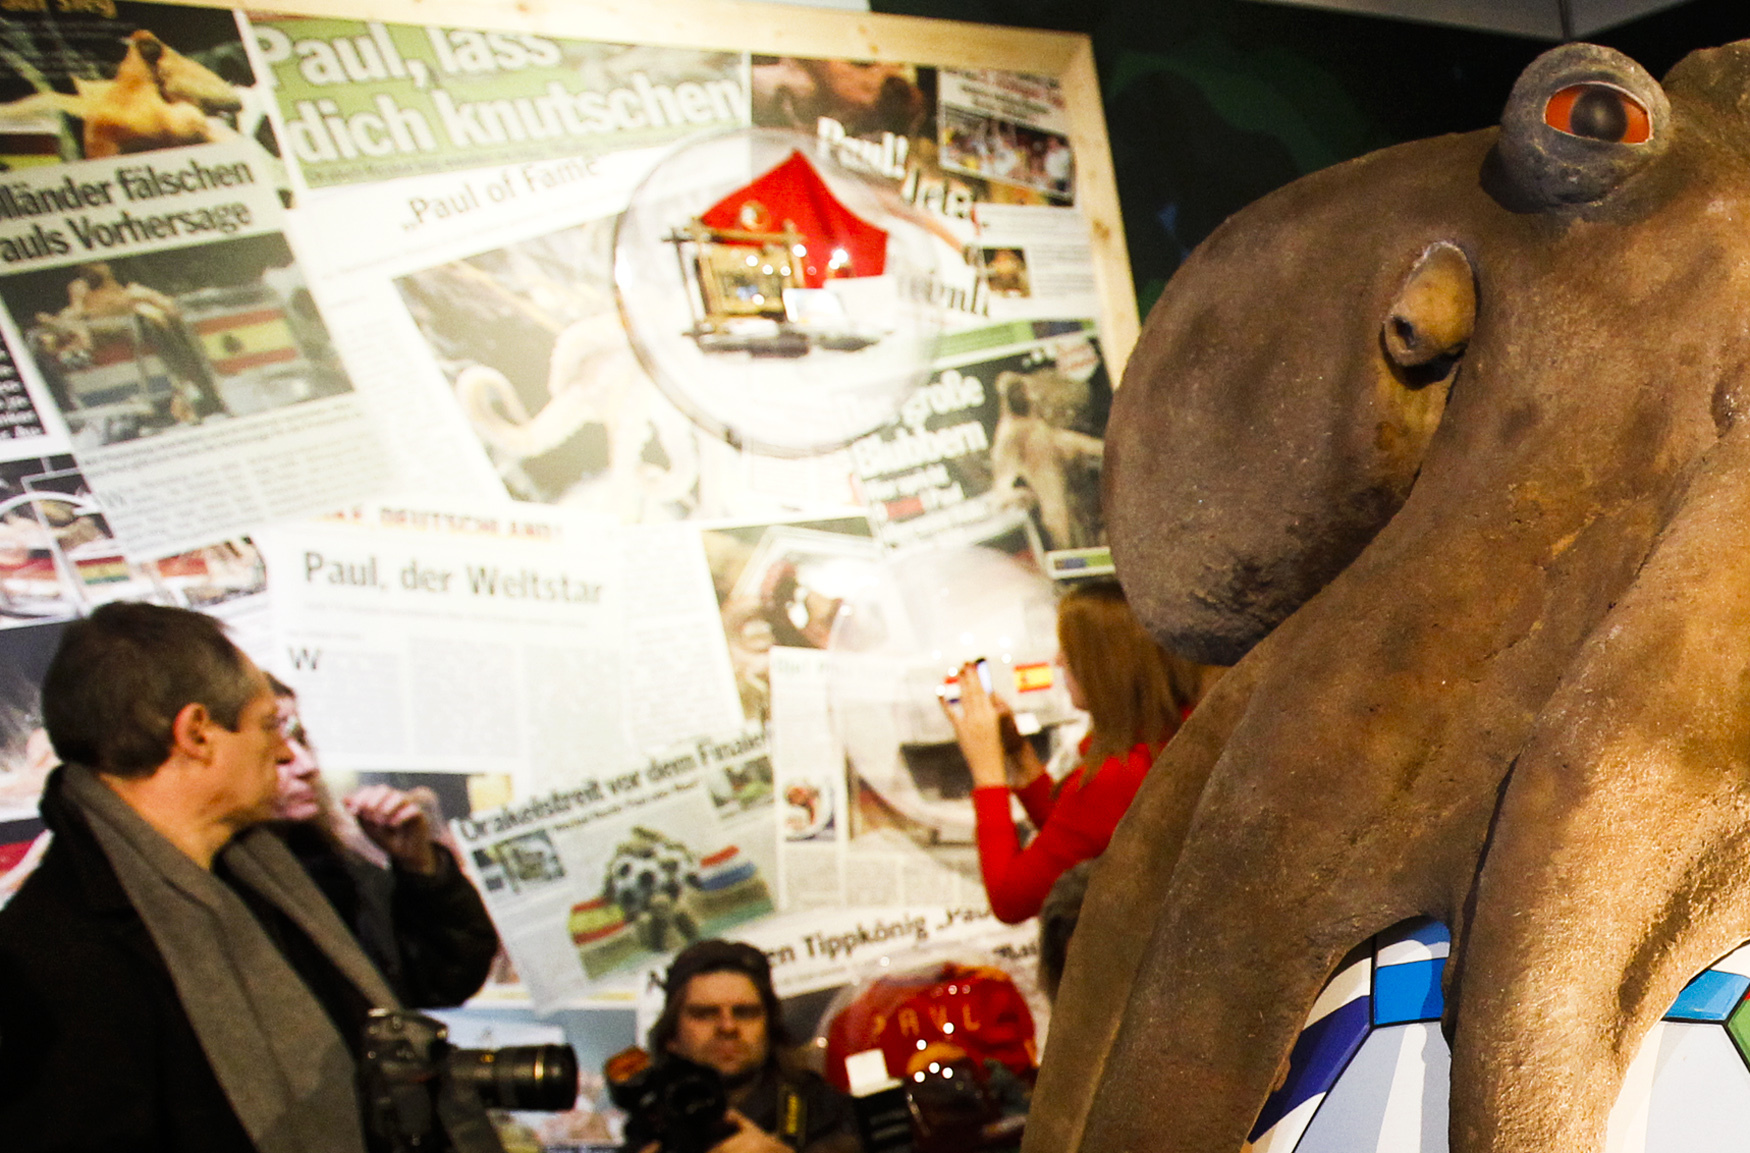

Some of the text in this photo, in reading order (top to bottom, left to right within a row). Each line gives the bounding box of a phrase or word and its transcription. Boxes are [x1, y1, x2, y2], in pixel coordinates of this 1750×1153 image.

[255, 20, 562, 90] Paul, lass
[284, 93, 436, 165] dich
[433, 70, 745, 148] knutschen
[487, 170, 516, 203] of
[66, 202, 255, 250] Vorhersage
[400, 558, 453, 594] der
[466, 564, 606, 606] Weltstar
[606, 770, 641, 795] vor
[803, 911, 928, 959] Tippkönig
